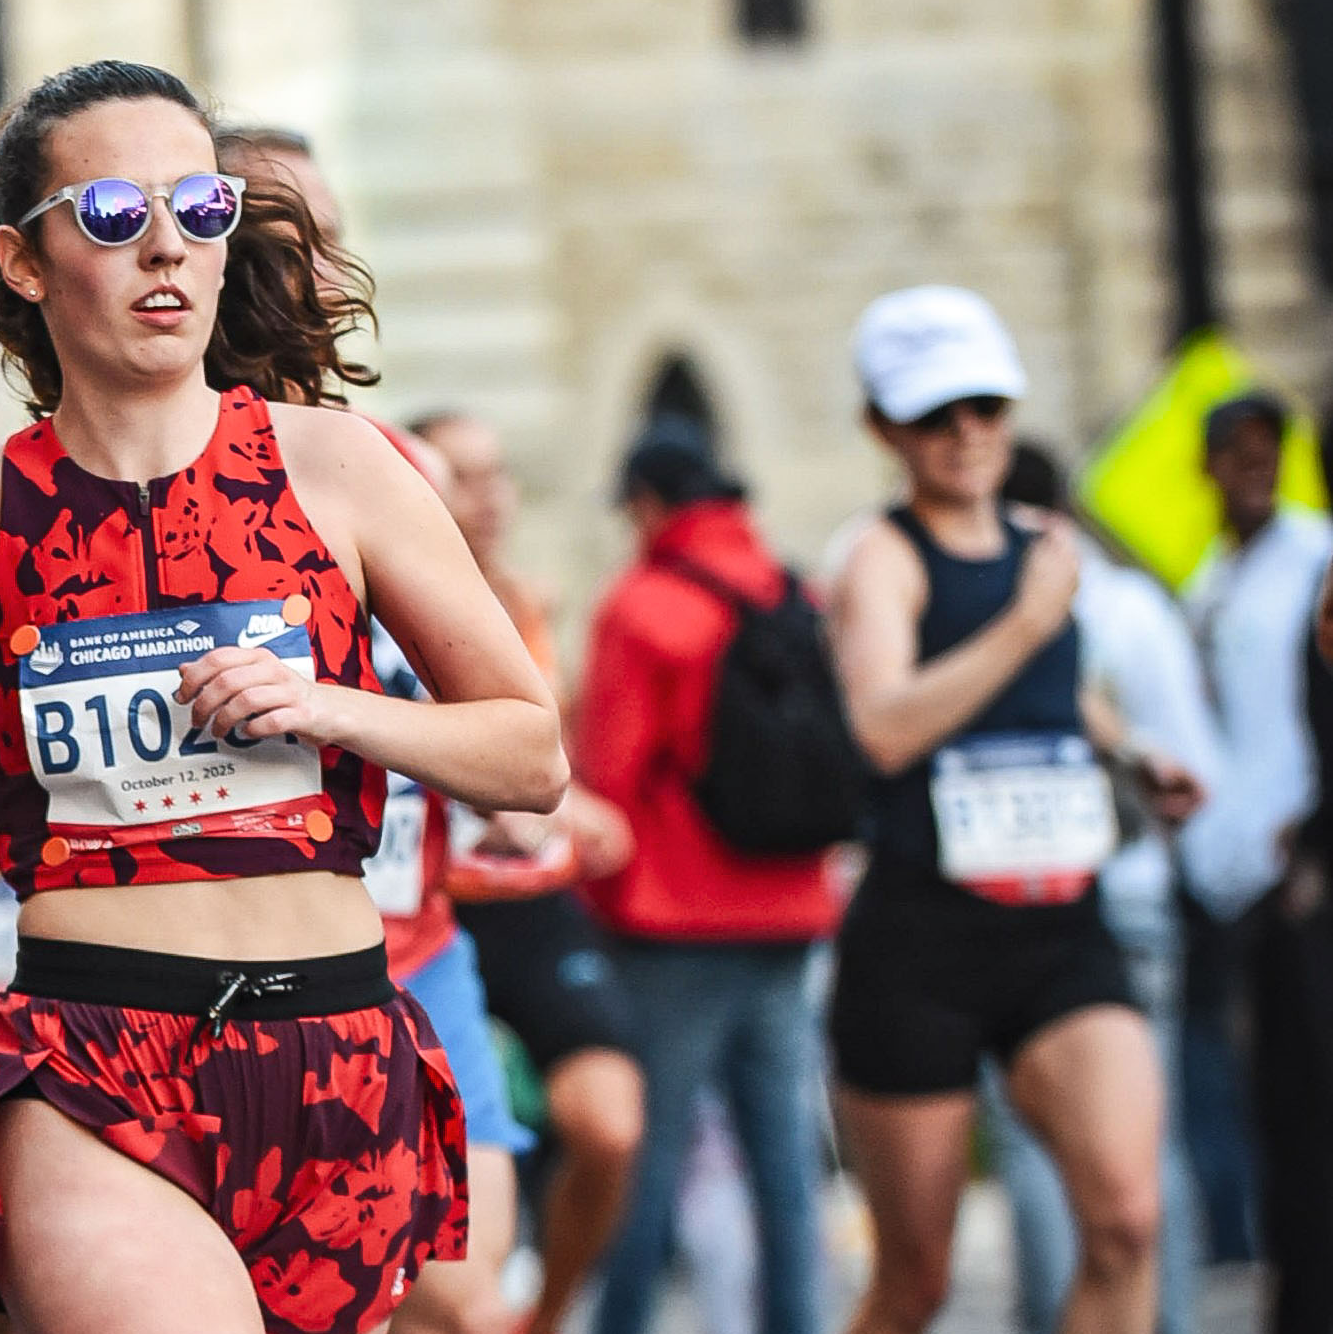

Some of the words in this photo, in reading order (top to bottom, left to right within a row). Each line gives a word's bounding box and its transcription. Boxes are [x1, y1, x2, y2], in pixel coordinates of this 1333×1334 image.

[69, 635, 102, 649] BANK
[103, 632, 120, 644] OF
[120, 626, 176, 642] AMERICA
[70, 645, 132, 666] CHICAGO
[133, 635, 216, 658] MARATHON
[120, 774, 175, 792] October
[178, 770, 199, 783] 12,
[202, 762, 236, 780] 2025
